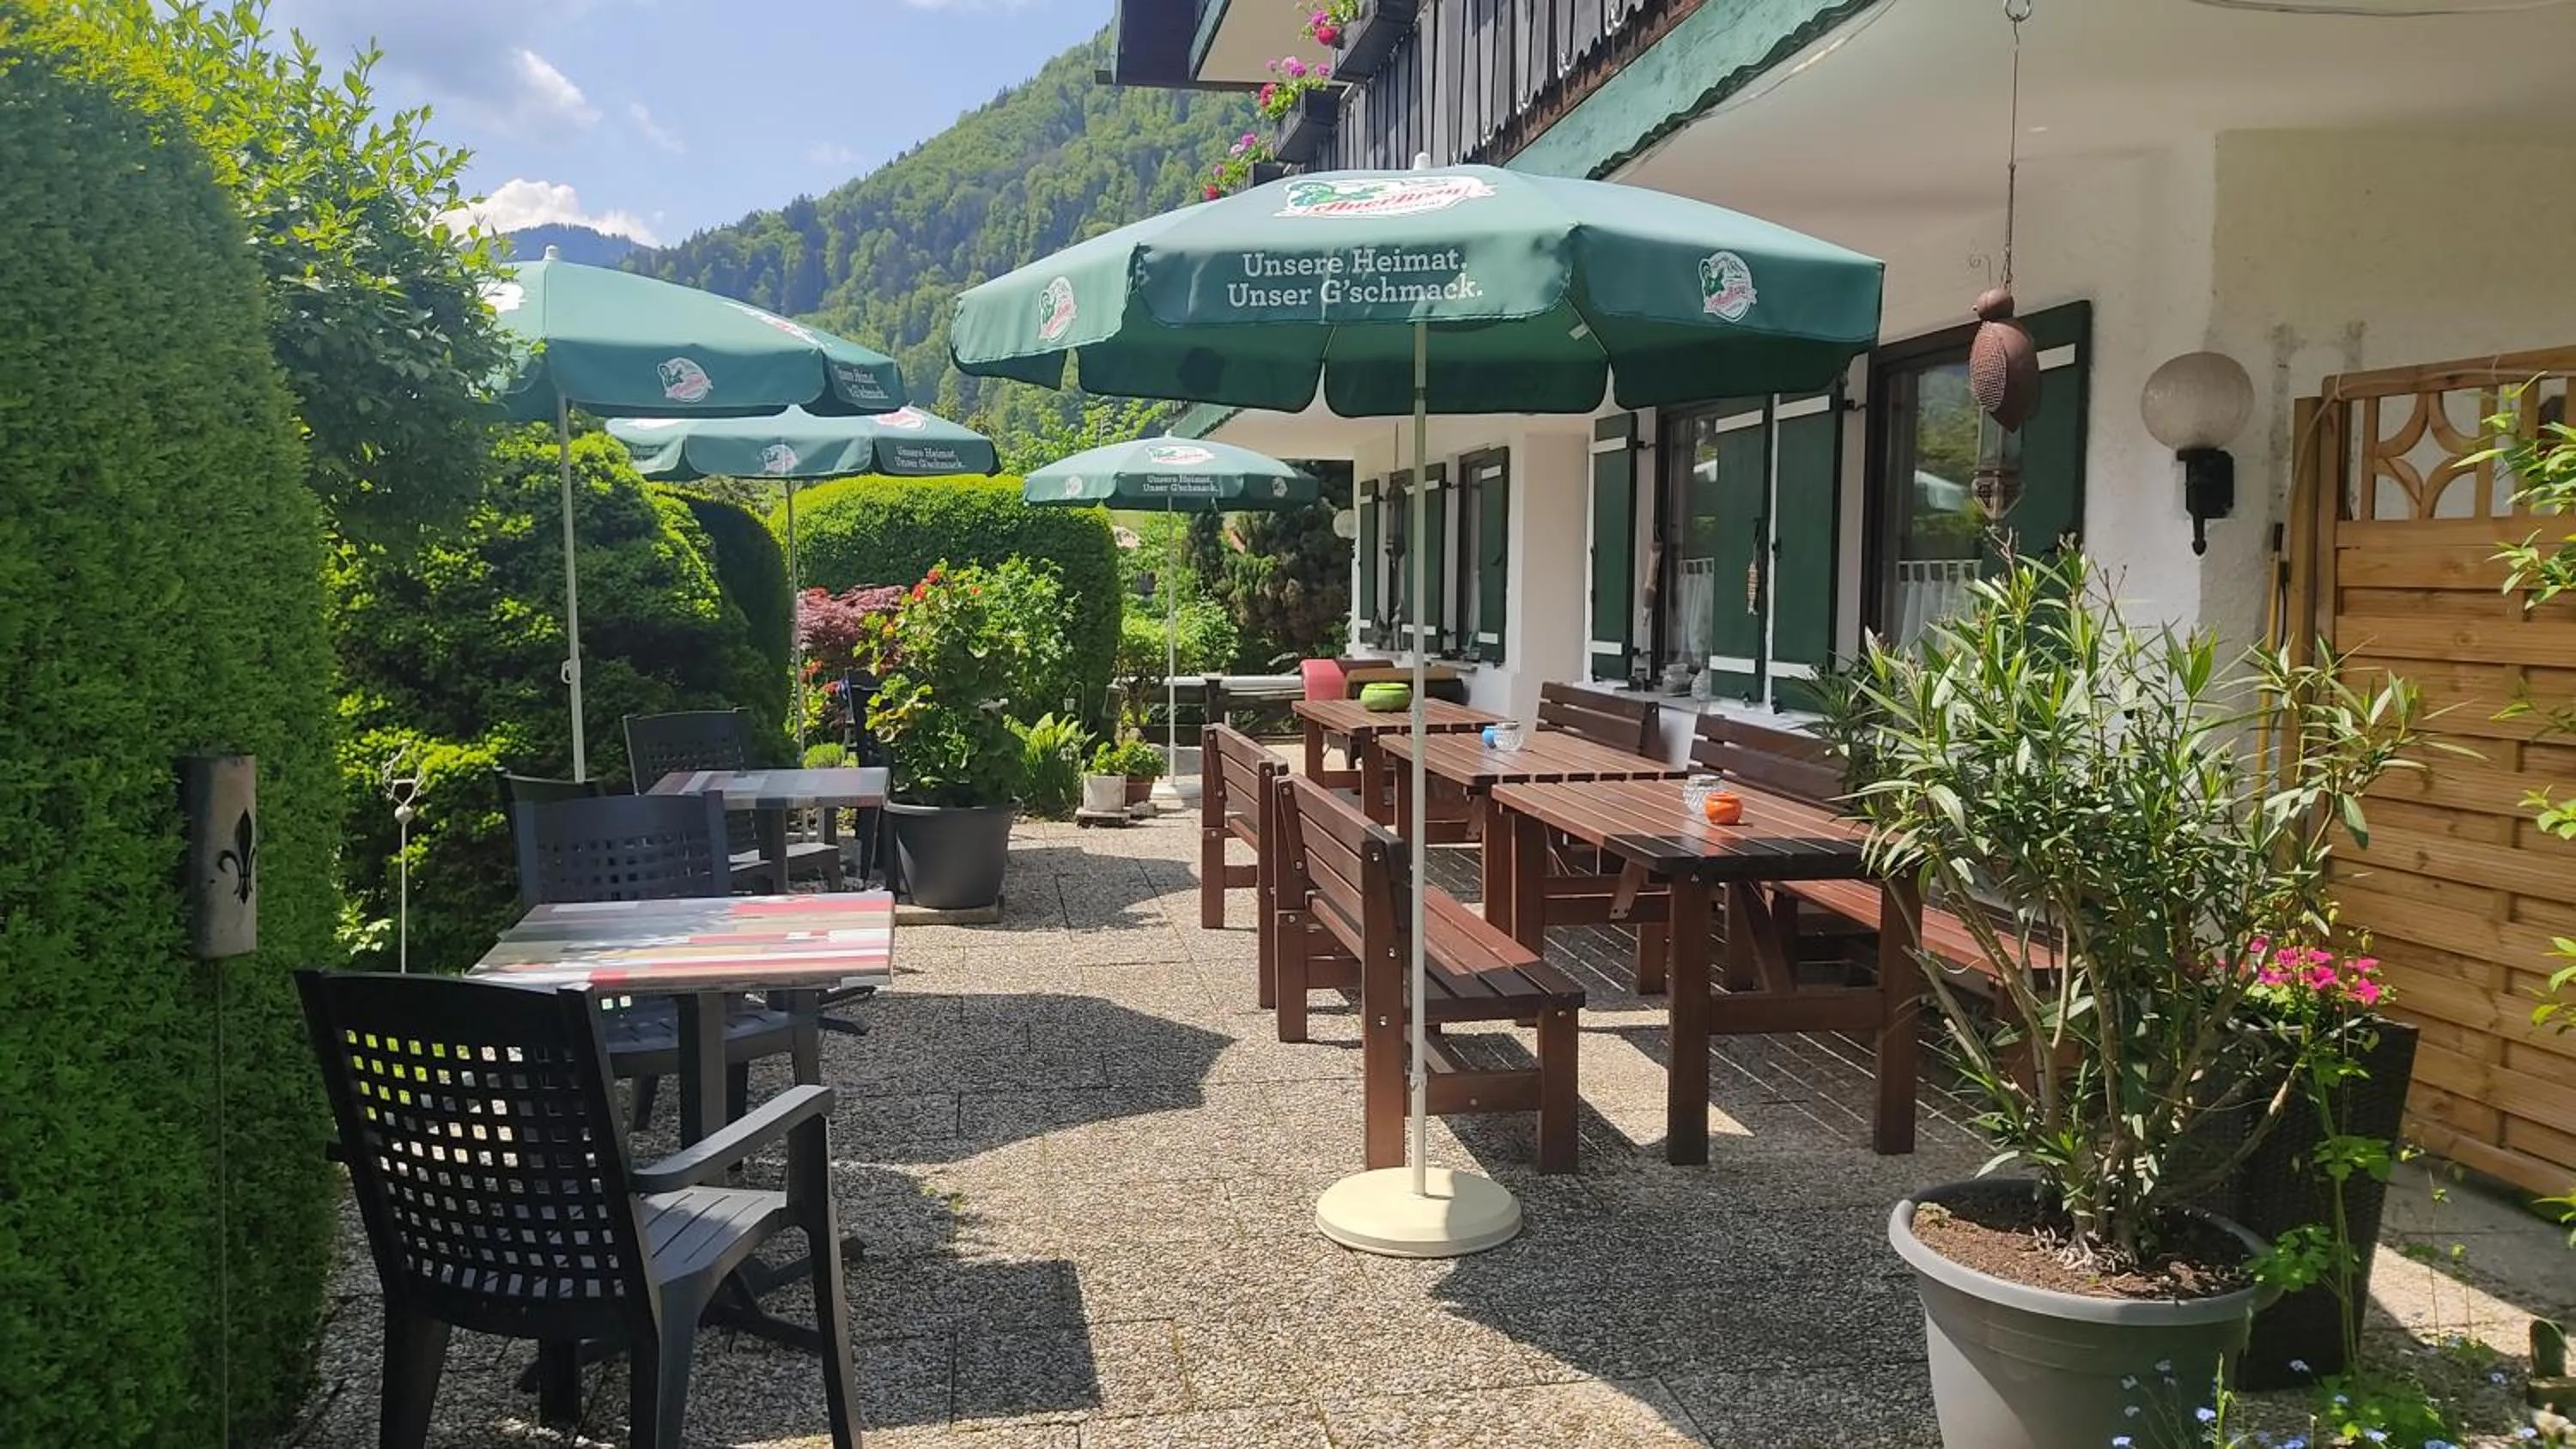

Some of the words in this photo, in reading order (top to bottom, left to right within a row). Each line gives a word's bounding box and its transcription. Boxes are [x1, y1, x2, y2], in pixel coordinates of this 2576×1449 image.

[1242, 252, 1344, 277] Unsere
[1352, 247, 1468, 273] Heimat.
[1227, 282, 1313, 307] Unser
[1320, 272, 1484, 303] G'schmack.
